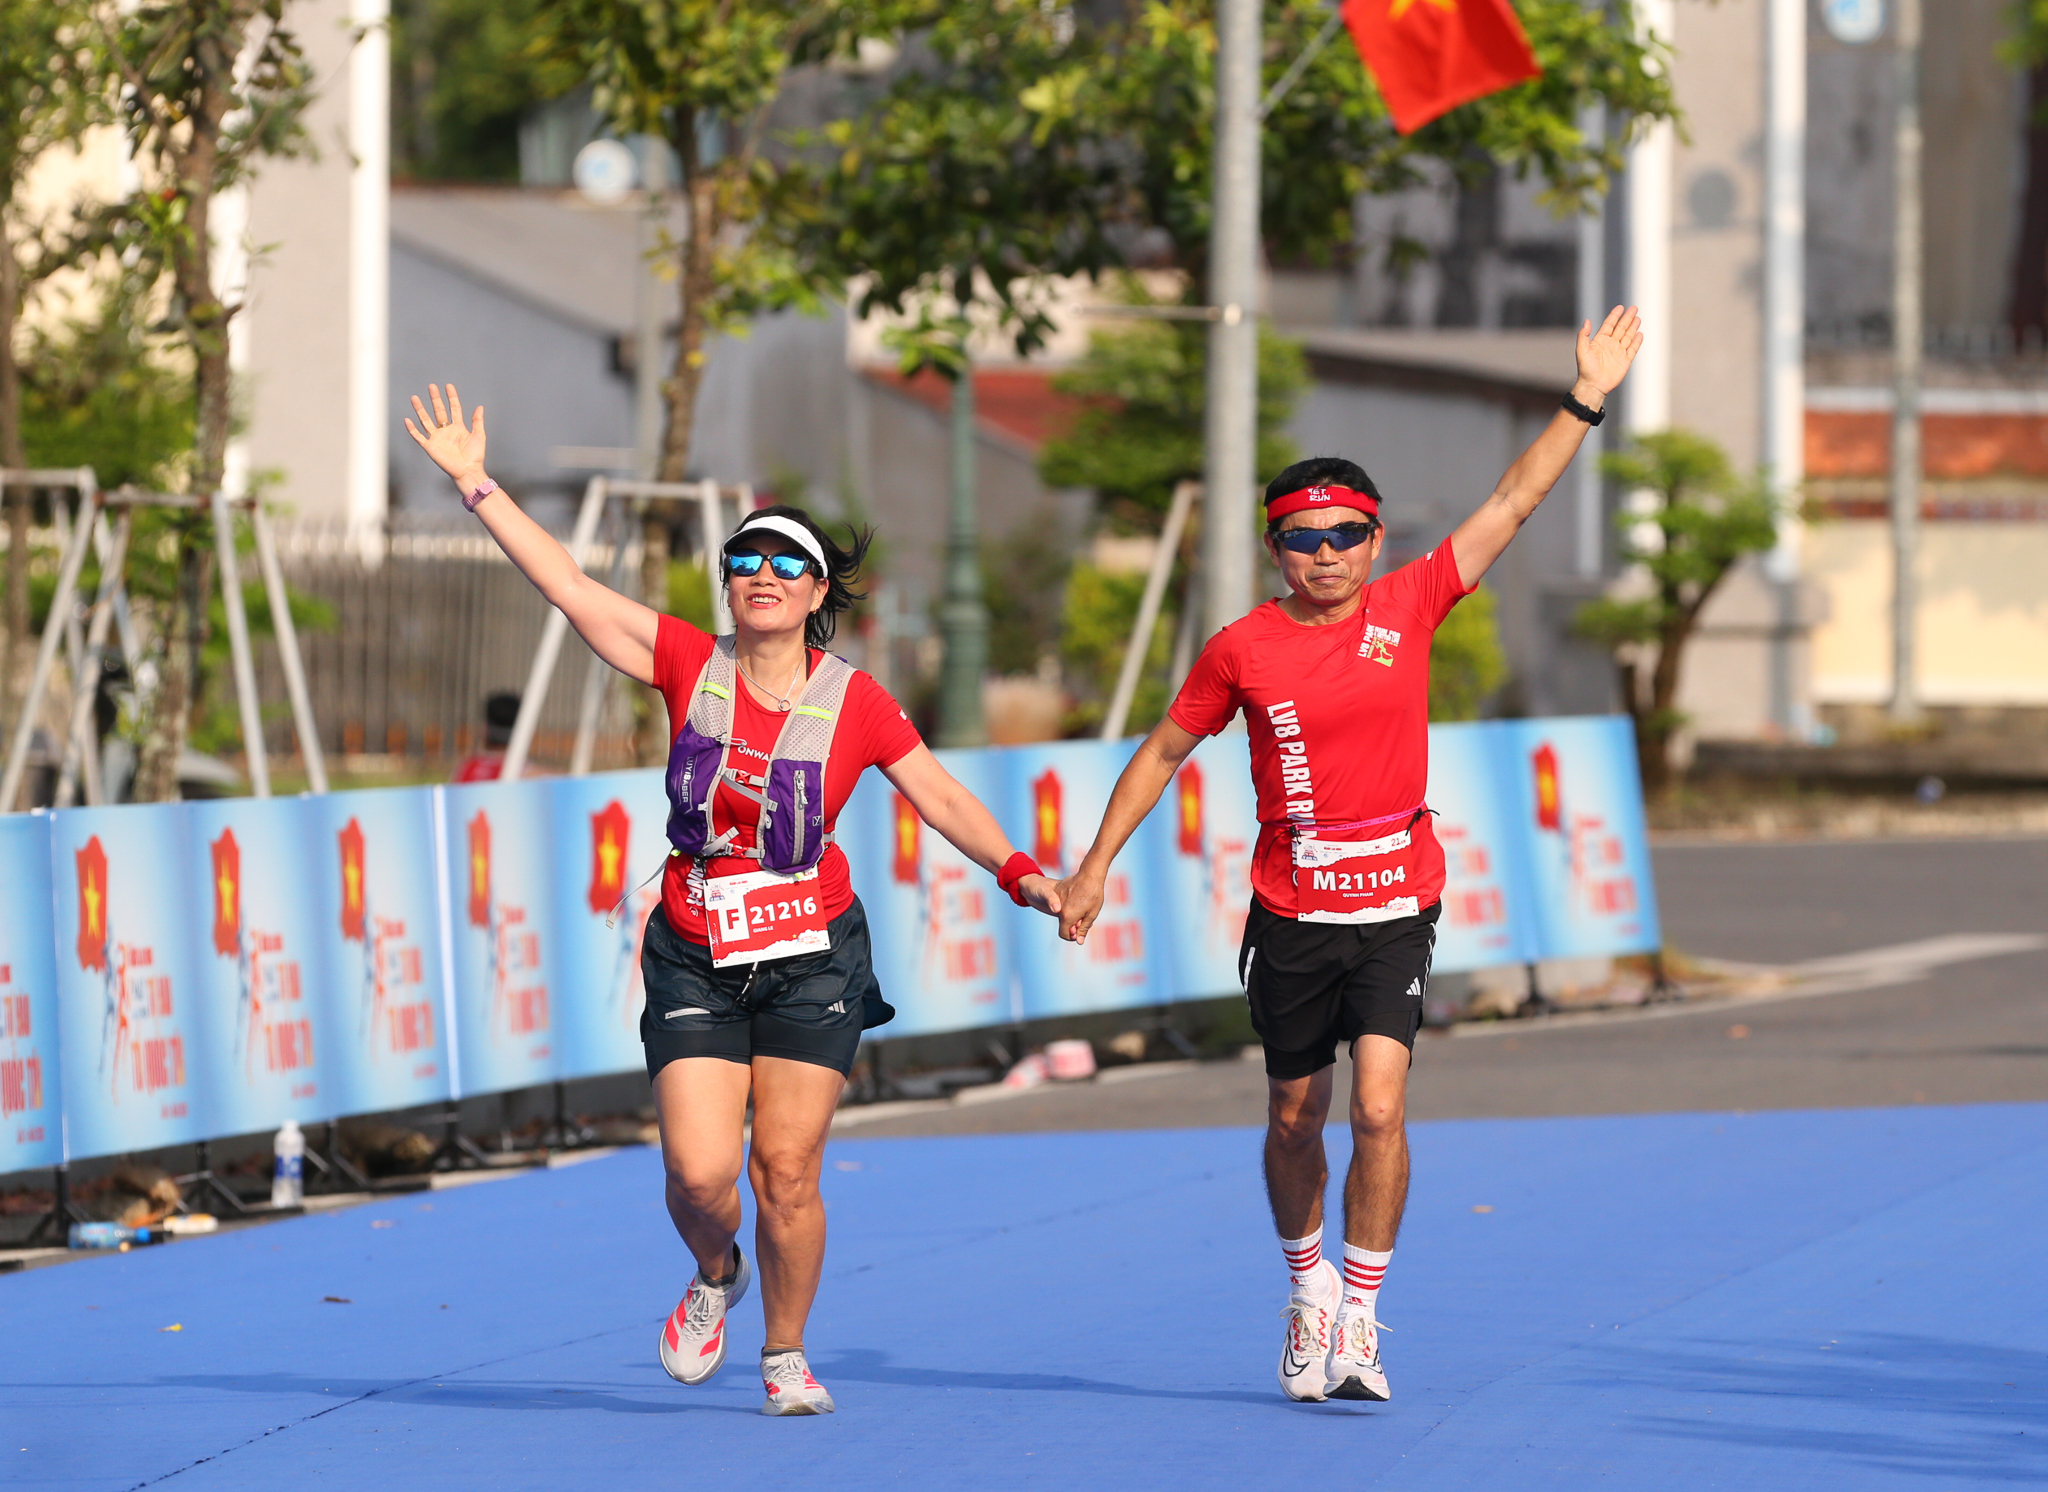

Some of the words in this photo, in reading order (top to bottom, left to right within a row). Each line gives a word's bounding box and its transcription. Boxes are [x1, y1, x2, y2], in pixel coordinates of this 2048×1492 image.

[1309, 494, 1331, 502] RUN
[1357, 642, 1370, 658] LV8
[1266, 700, 1302, 739] LV8
[1278, 741, 1313, 796] PARK
[1313, 865, 1406, 891] M21104
[726, 908, 740, 930] F
[749, 896, 817, 924] 21216
